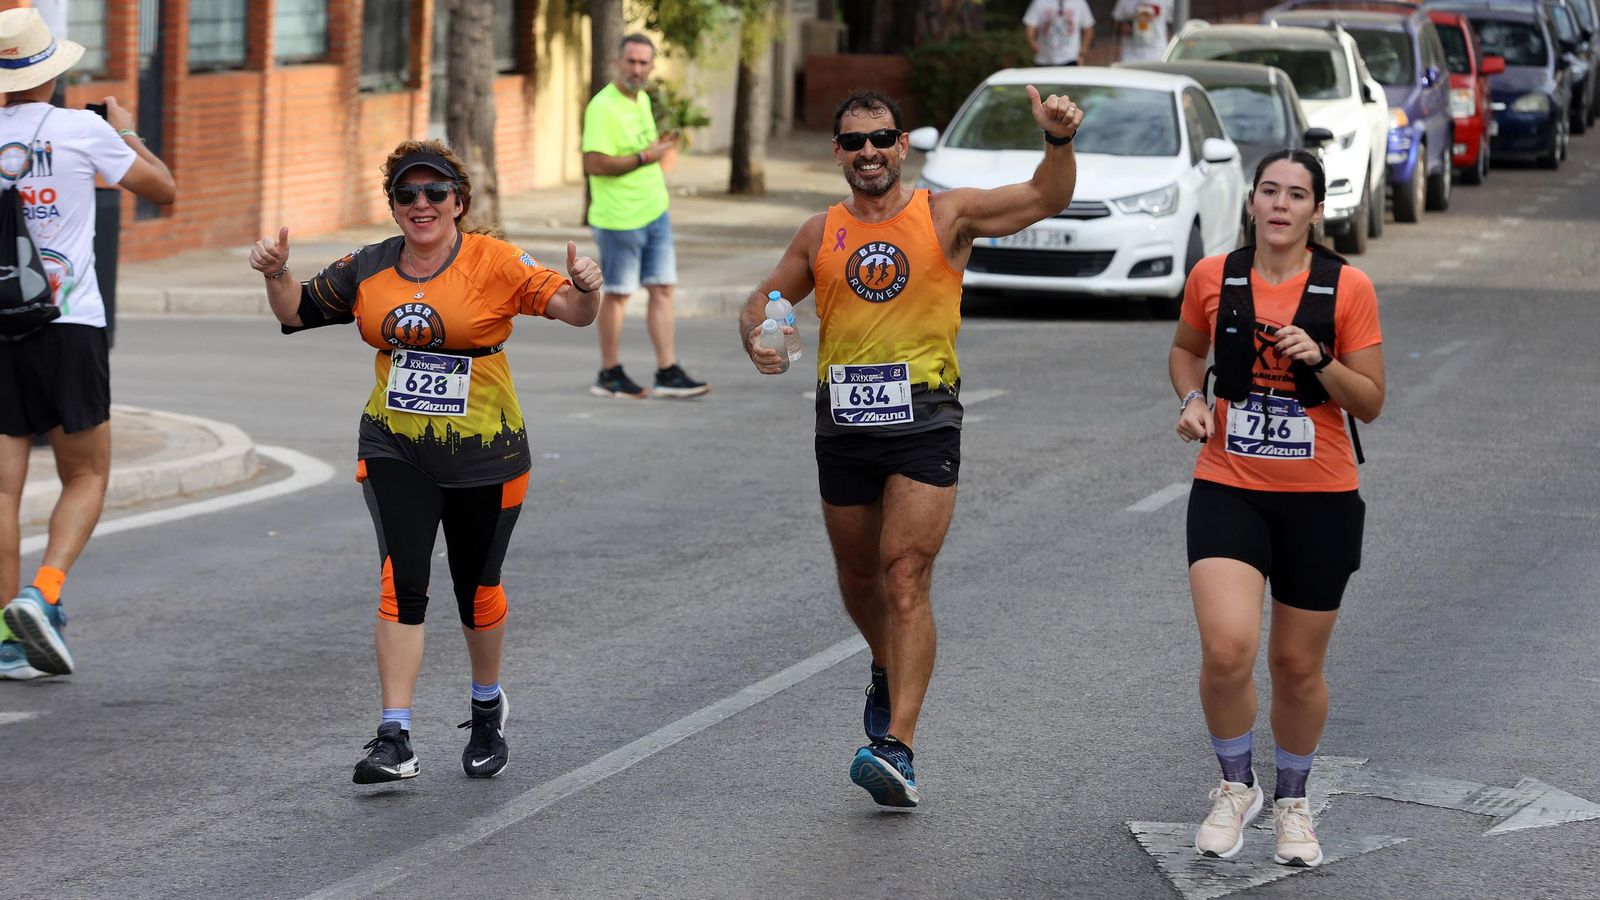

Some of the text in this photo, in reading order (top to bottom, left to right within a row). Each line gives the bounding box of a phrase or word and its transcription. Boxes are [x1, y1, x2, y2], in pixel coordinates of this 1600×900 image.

[859, 243, 896, 258] BEER
[850, 276, 906, 301] RUNNERS
[394, 303, 432, 319] BEER
[405, 372, 448, 395] 628
[849, 384, 890, 405] 634
[1251, 401, 1272, 413] XXX
[1246, 414, 1291, 439] 746
